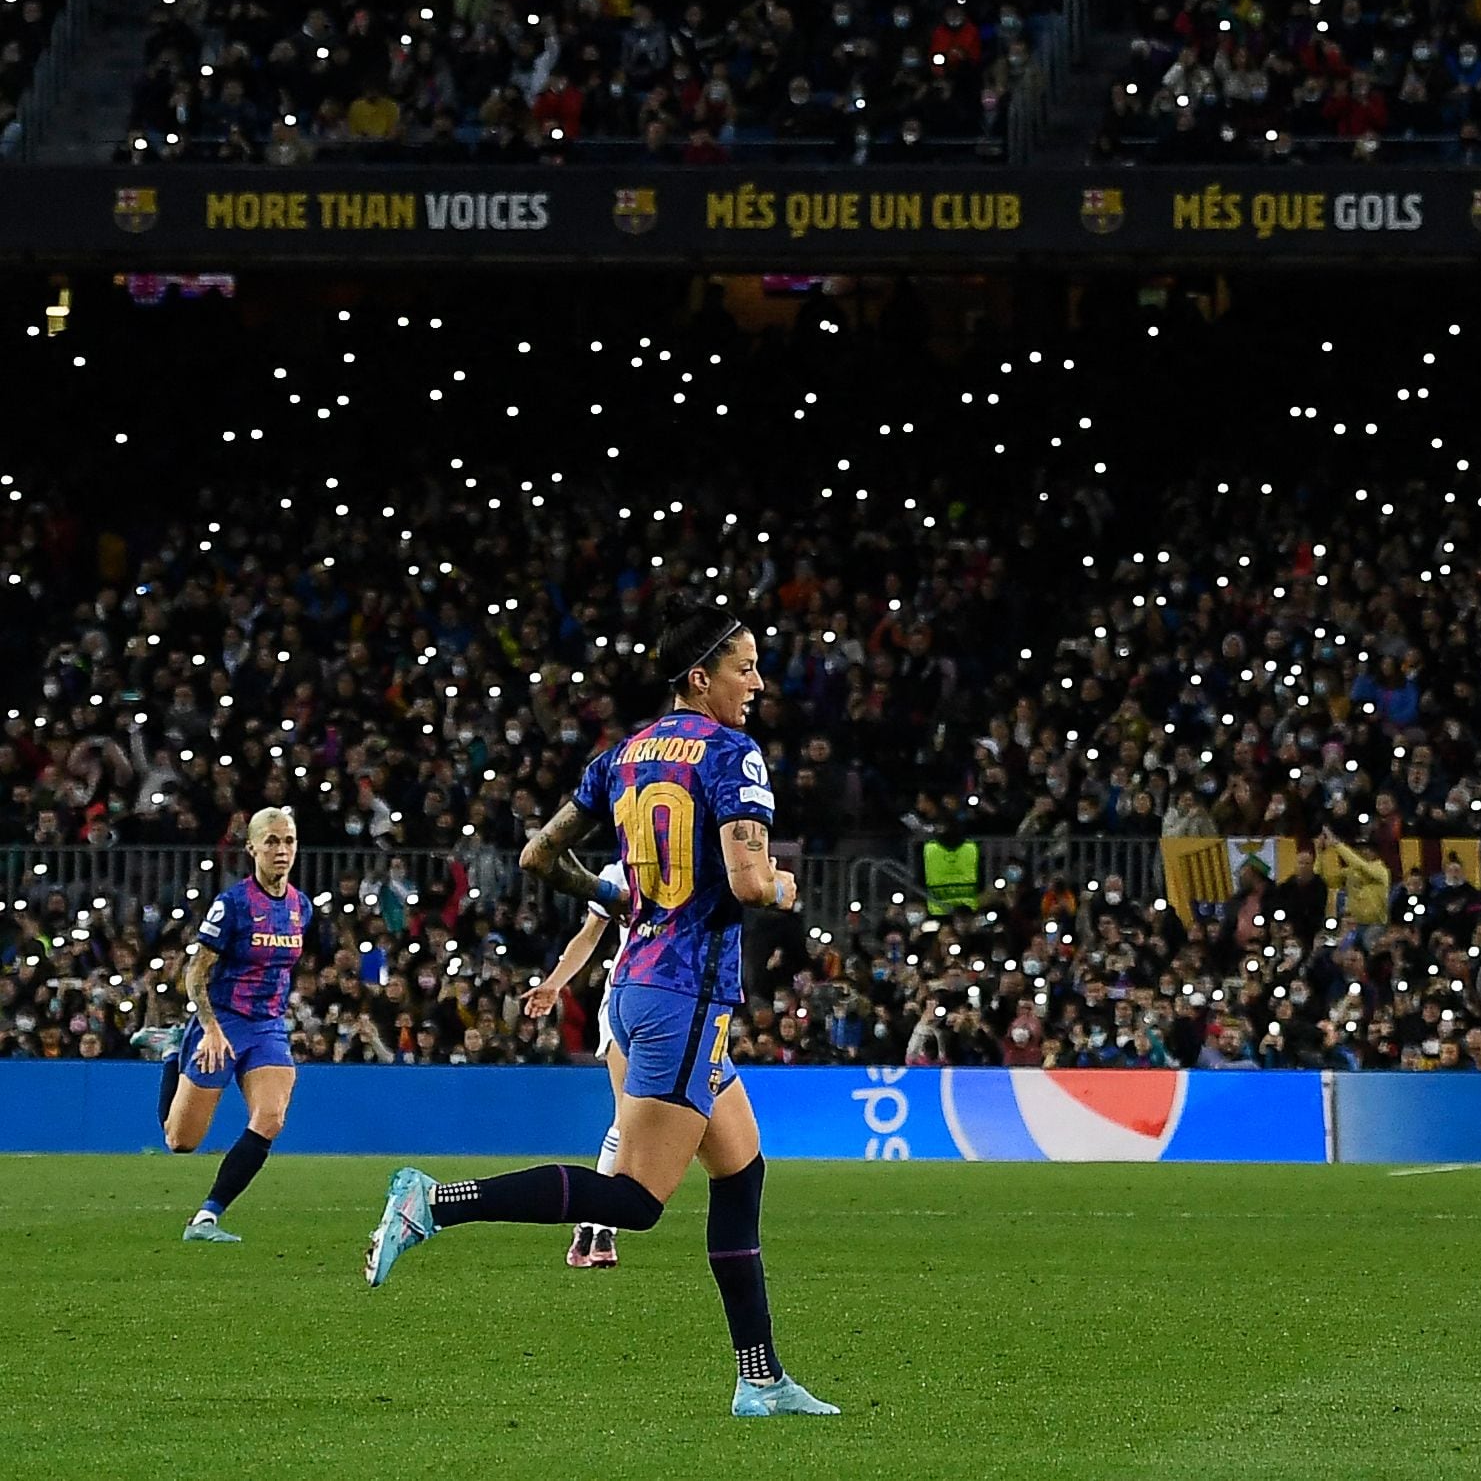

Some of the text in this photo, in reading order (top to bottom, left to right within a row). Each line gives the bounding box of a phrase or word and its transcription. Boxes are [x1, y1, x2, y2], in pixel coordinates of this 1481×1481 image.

[206, 192, 550, 230] MORE THAN VOICES
[707, 184, 1022, 235] MÉS QUE UN CLUB
[1172, 182, 1422, 235] MÉS QUE GOLS
[614, 781, 695, 910] 10
